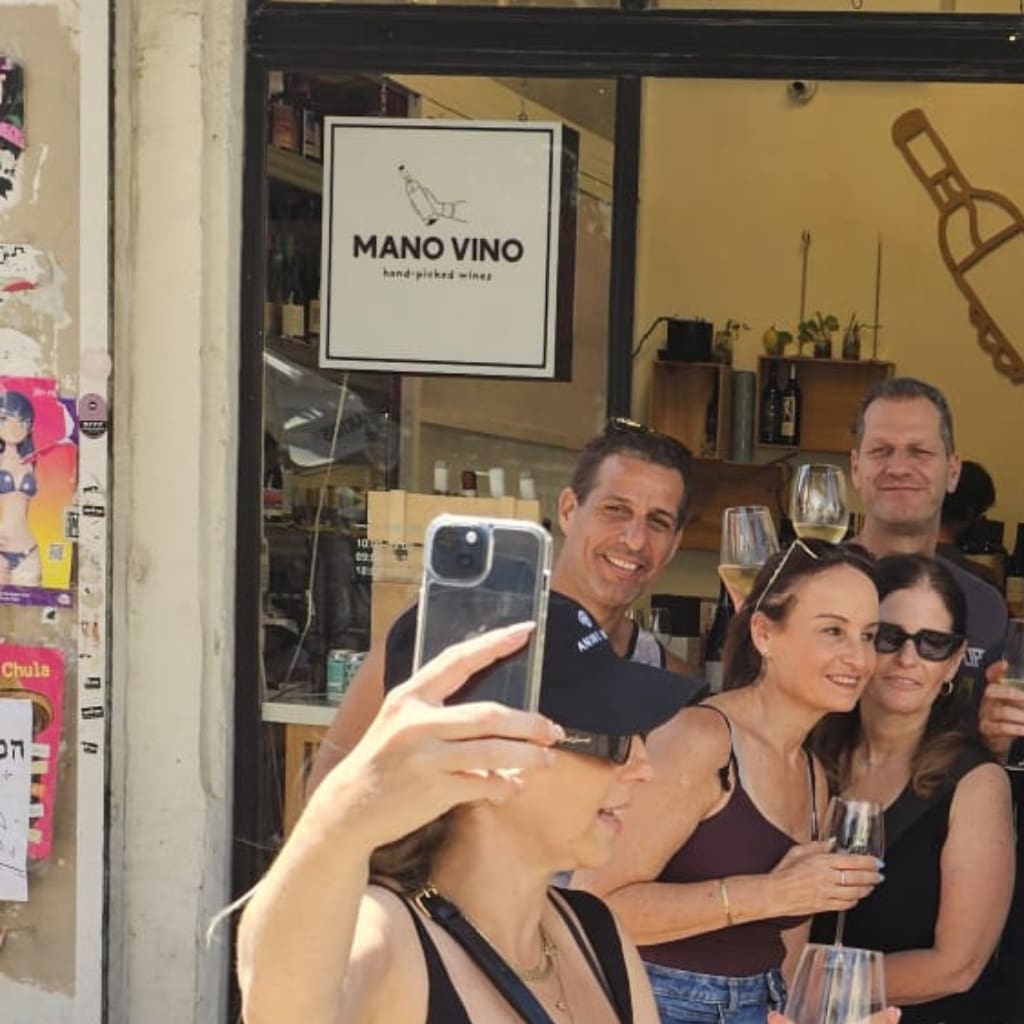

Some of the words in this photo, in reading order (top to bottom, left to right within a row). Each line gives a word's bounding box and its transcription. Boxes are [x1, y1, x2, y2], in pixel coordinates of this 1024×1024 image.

[352, 234, 445, 260] MANO
[451, 236, 524, 263] VINO
[383, 267, 454, 281] hand-picked
[459, 270, 492, 281] wines
[2, 661, 50, 678] Chula
